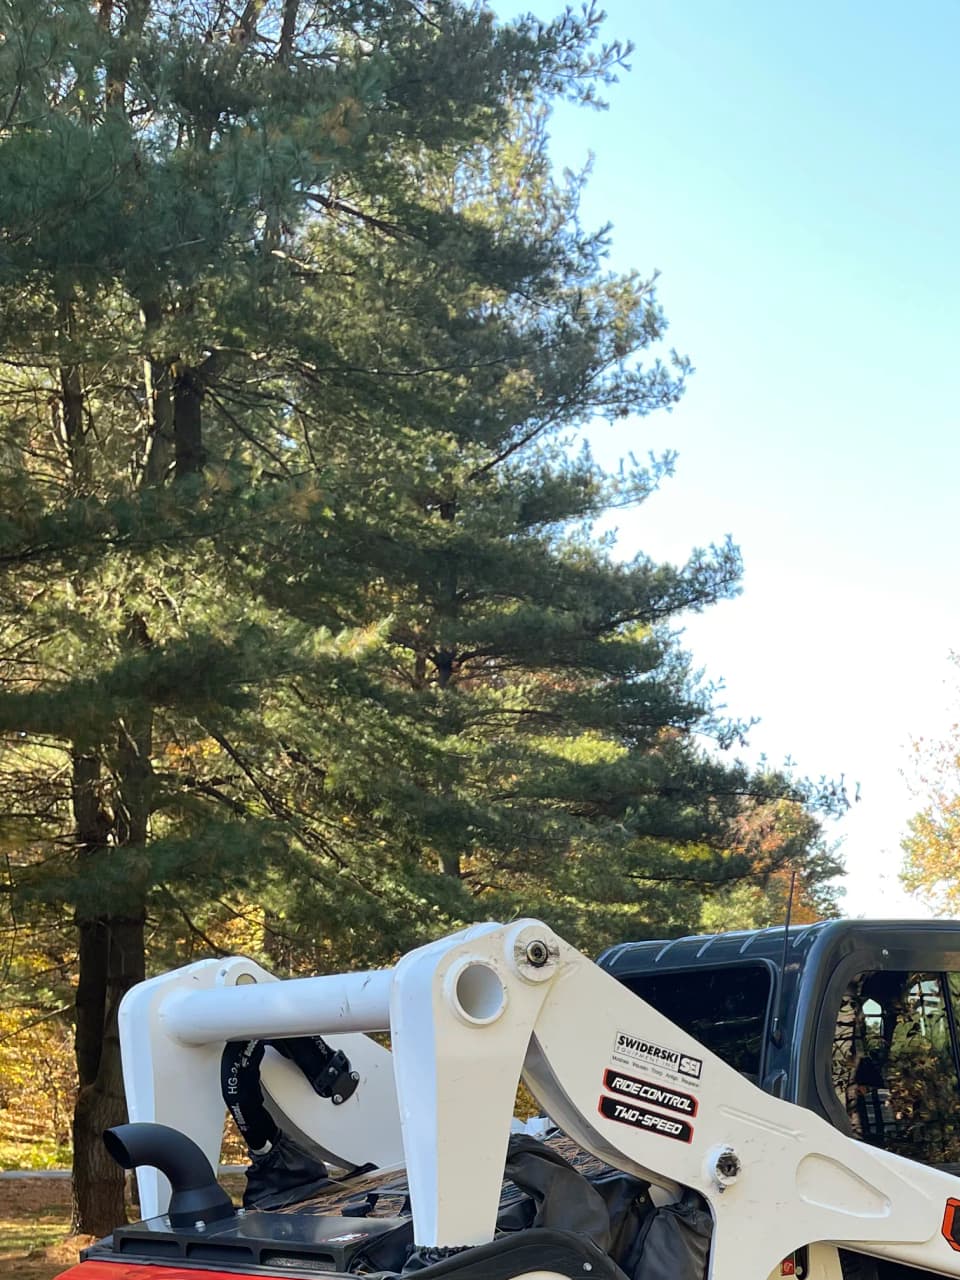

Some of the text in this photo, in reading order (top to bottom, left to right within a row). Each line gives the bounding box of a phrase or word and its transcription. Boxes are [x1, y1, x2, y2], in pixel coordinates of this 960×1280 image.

[617, 1035, 699, 1077] SWIDERSKI SEI
[614, 1105, 683, 1135] TWO-SPEED
